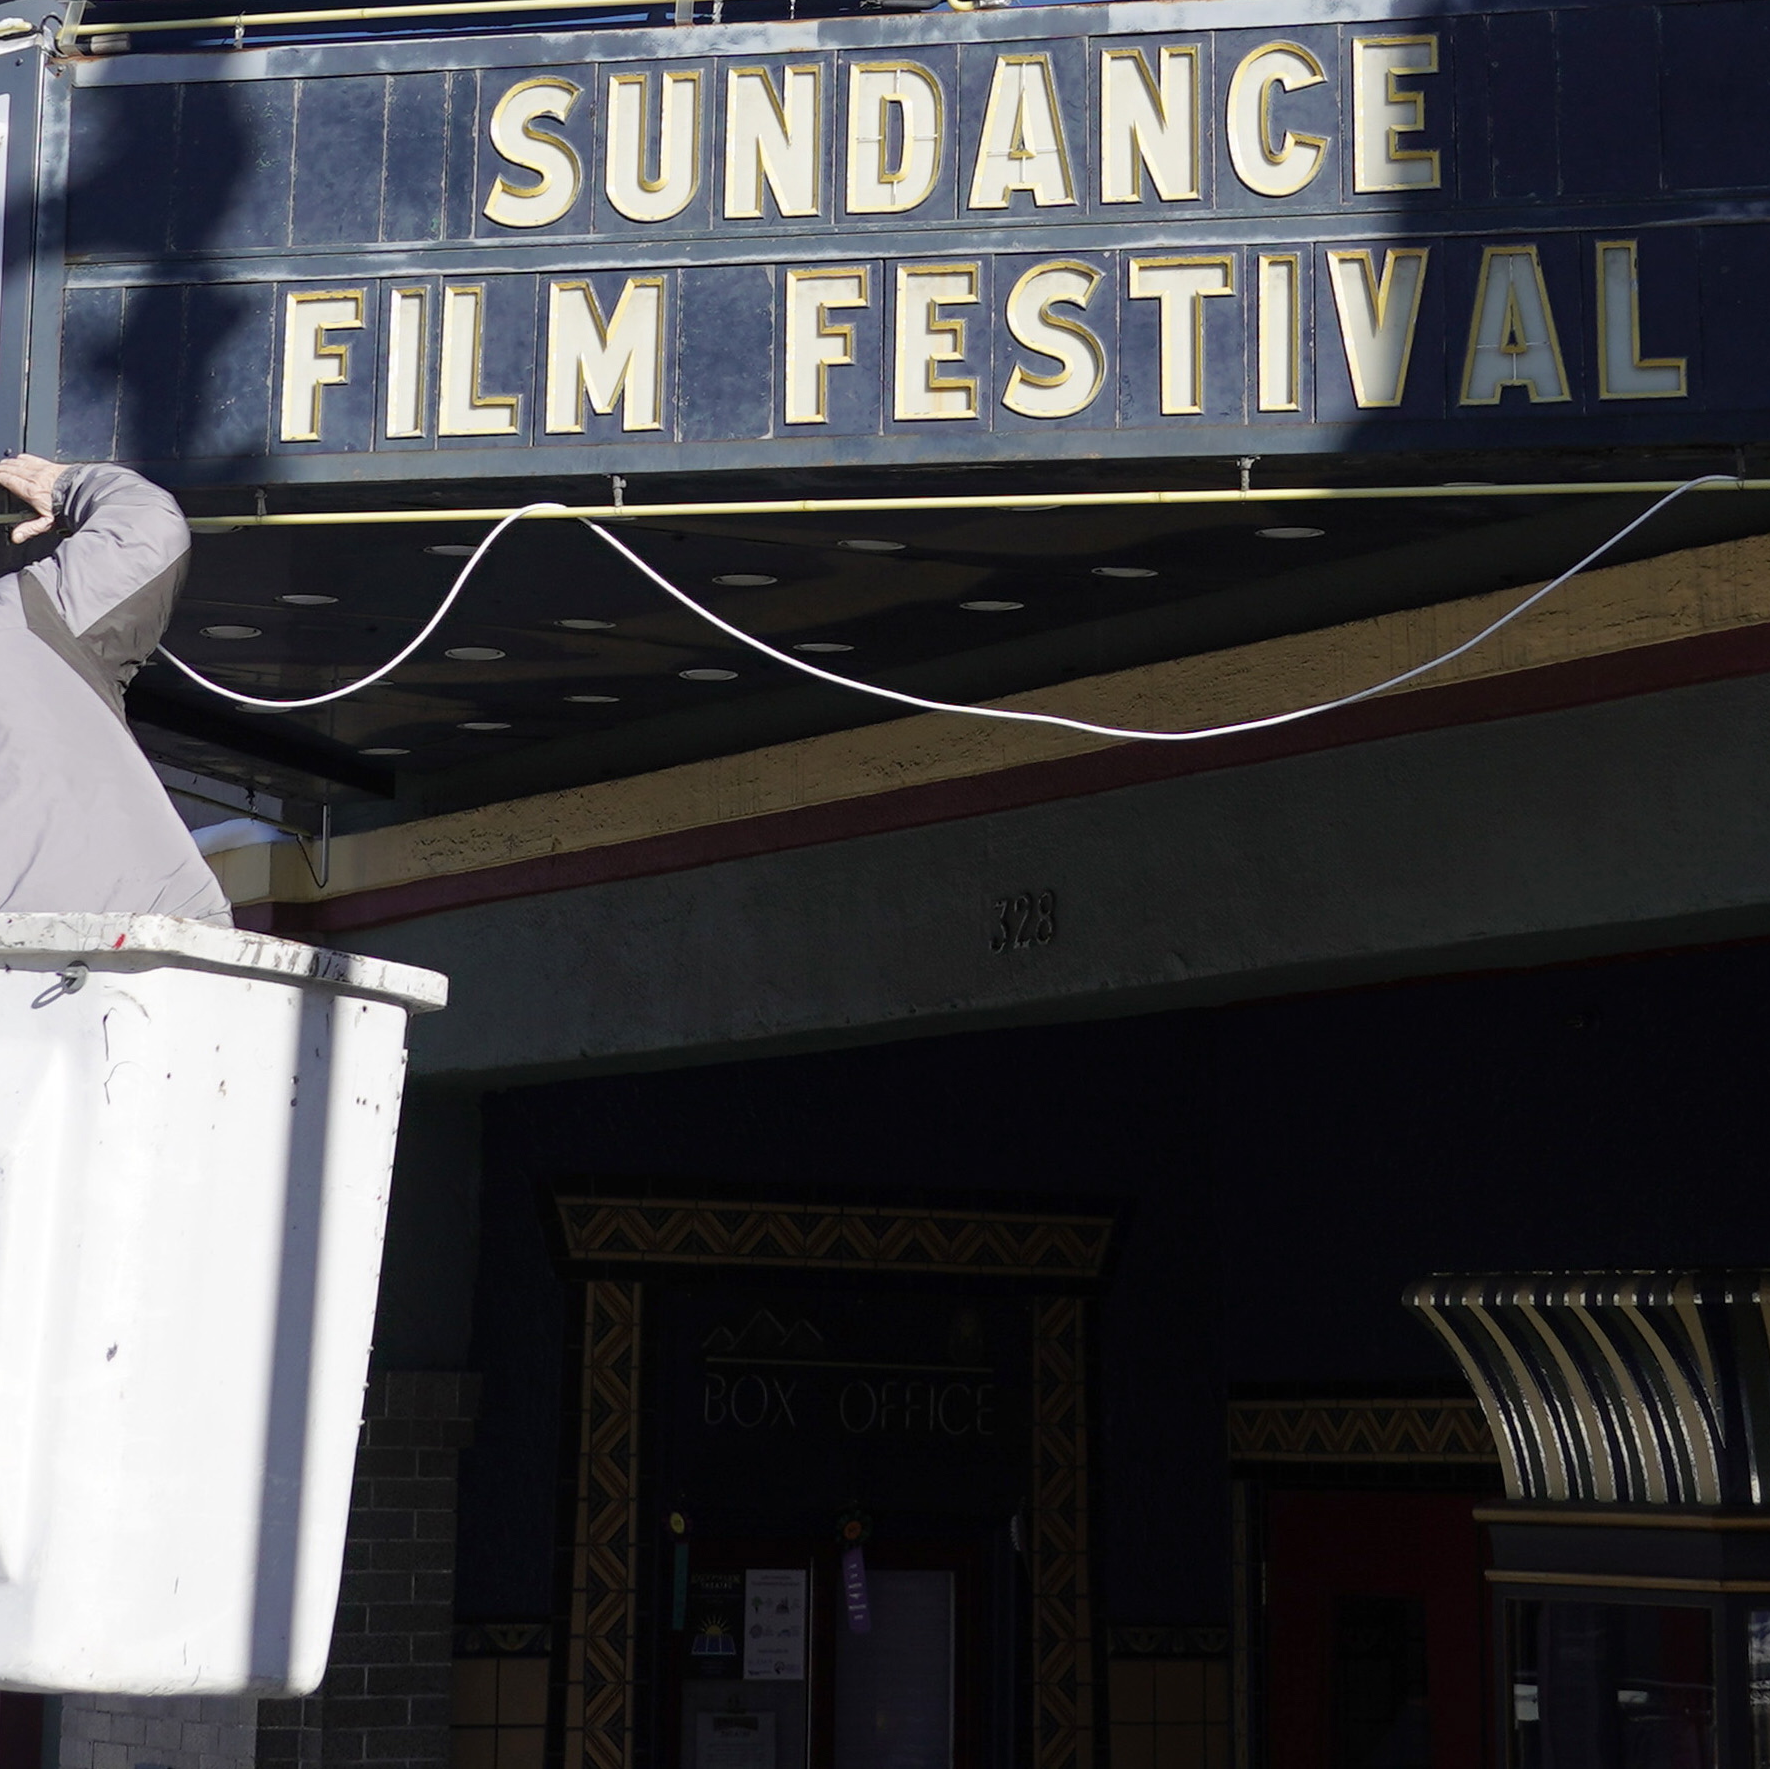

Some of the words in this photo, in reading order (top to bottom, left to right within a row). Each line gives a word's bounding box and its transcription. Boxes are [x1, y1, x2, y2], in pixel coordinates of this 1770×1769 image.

[482, 33, 1441, 228] SUNDANCE
[280, 274, 666, 442] FILM
[784, 238, 1689, 425] FESTIVAL
[989, 890, 1055, 953] 328
[703, 1372, 798, 1428] BOX
[838, 1379, 996, 1436] OFFICE
